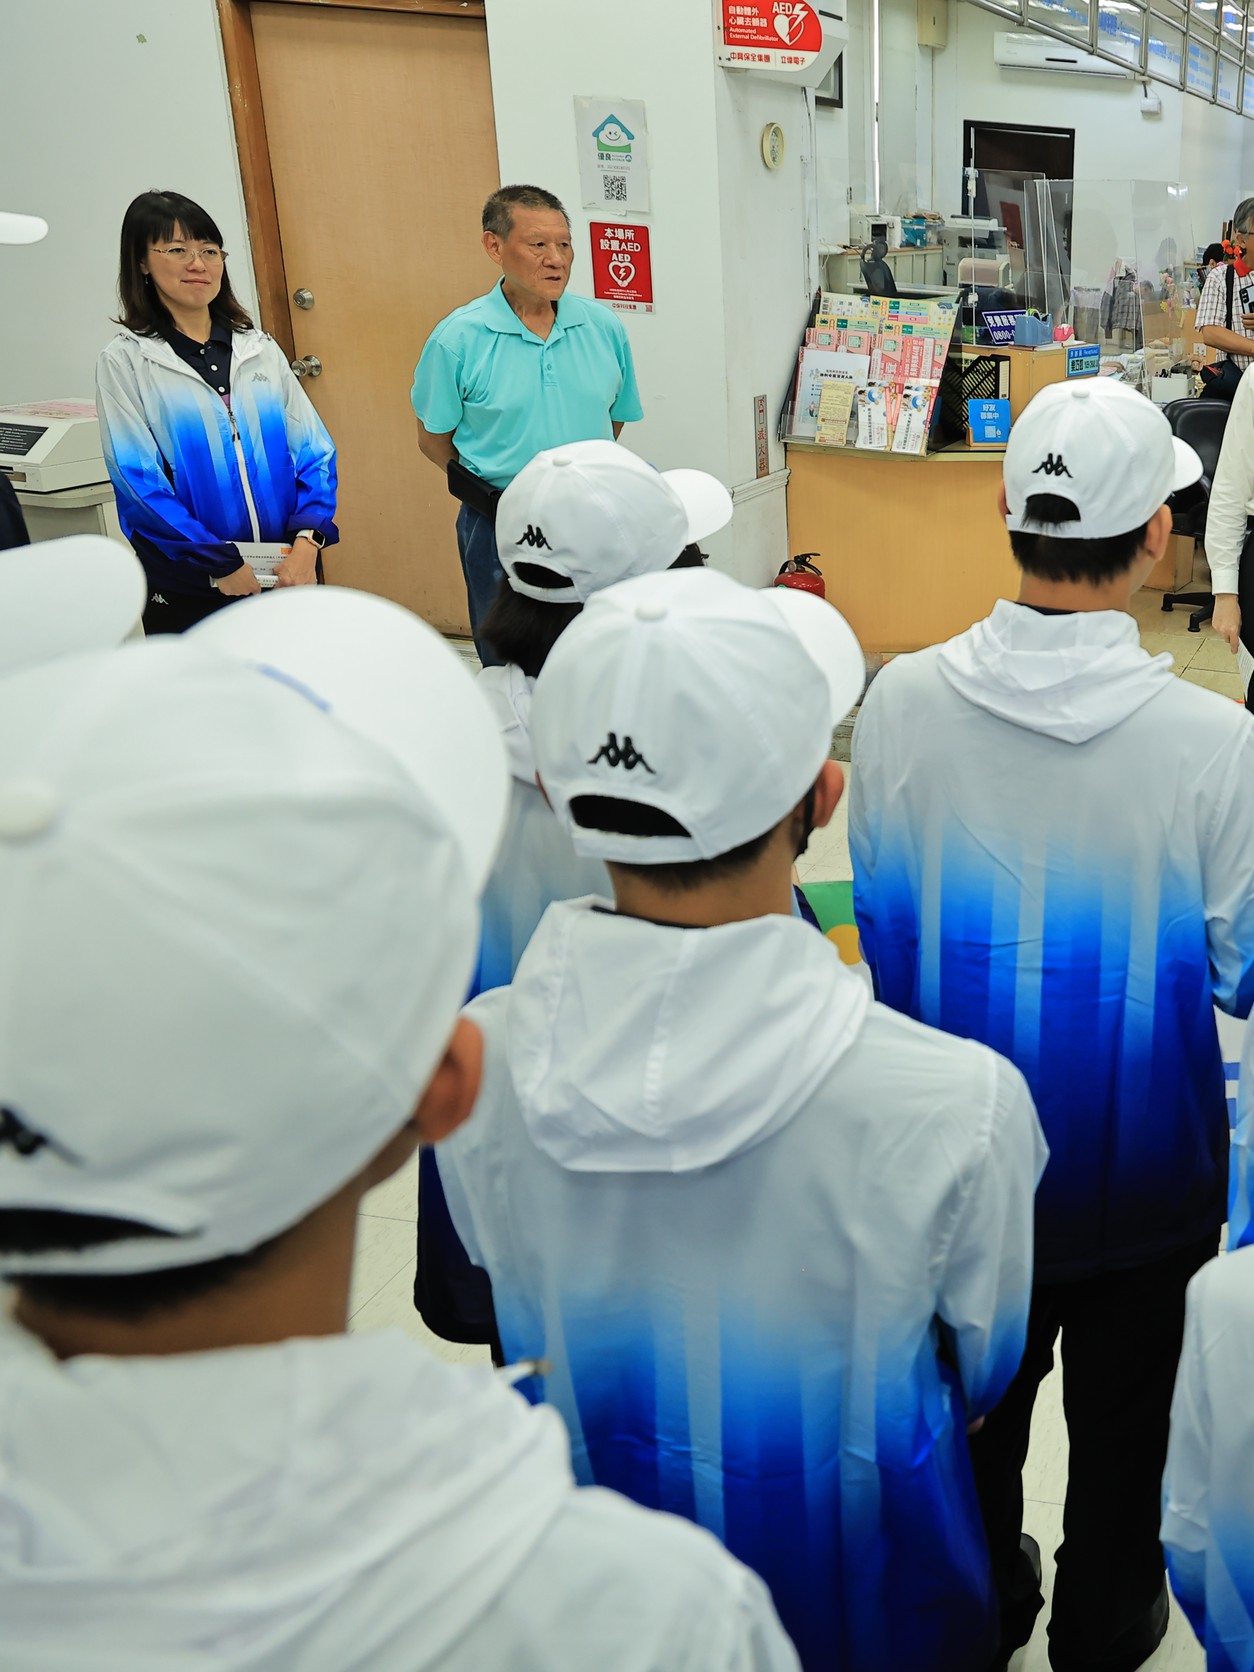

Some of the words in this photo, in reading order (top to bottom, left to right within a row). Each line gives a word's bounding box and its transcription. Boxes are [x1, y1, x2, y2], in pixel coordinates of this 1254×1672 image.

[728, 5, 760, 16] 自動體外
[772, 2, 793, 15] AED
[750, 34, 779, 42] Defibrillator
[604, 227, 635, 241] 本場所
[611, 252, 632, 262] AED
[982, 404, 996, 412] 好友
